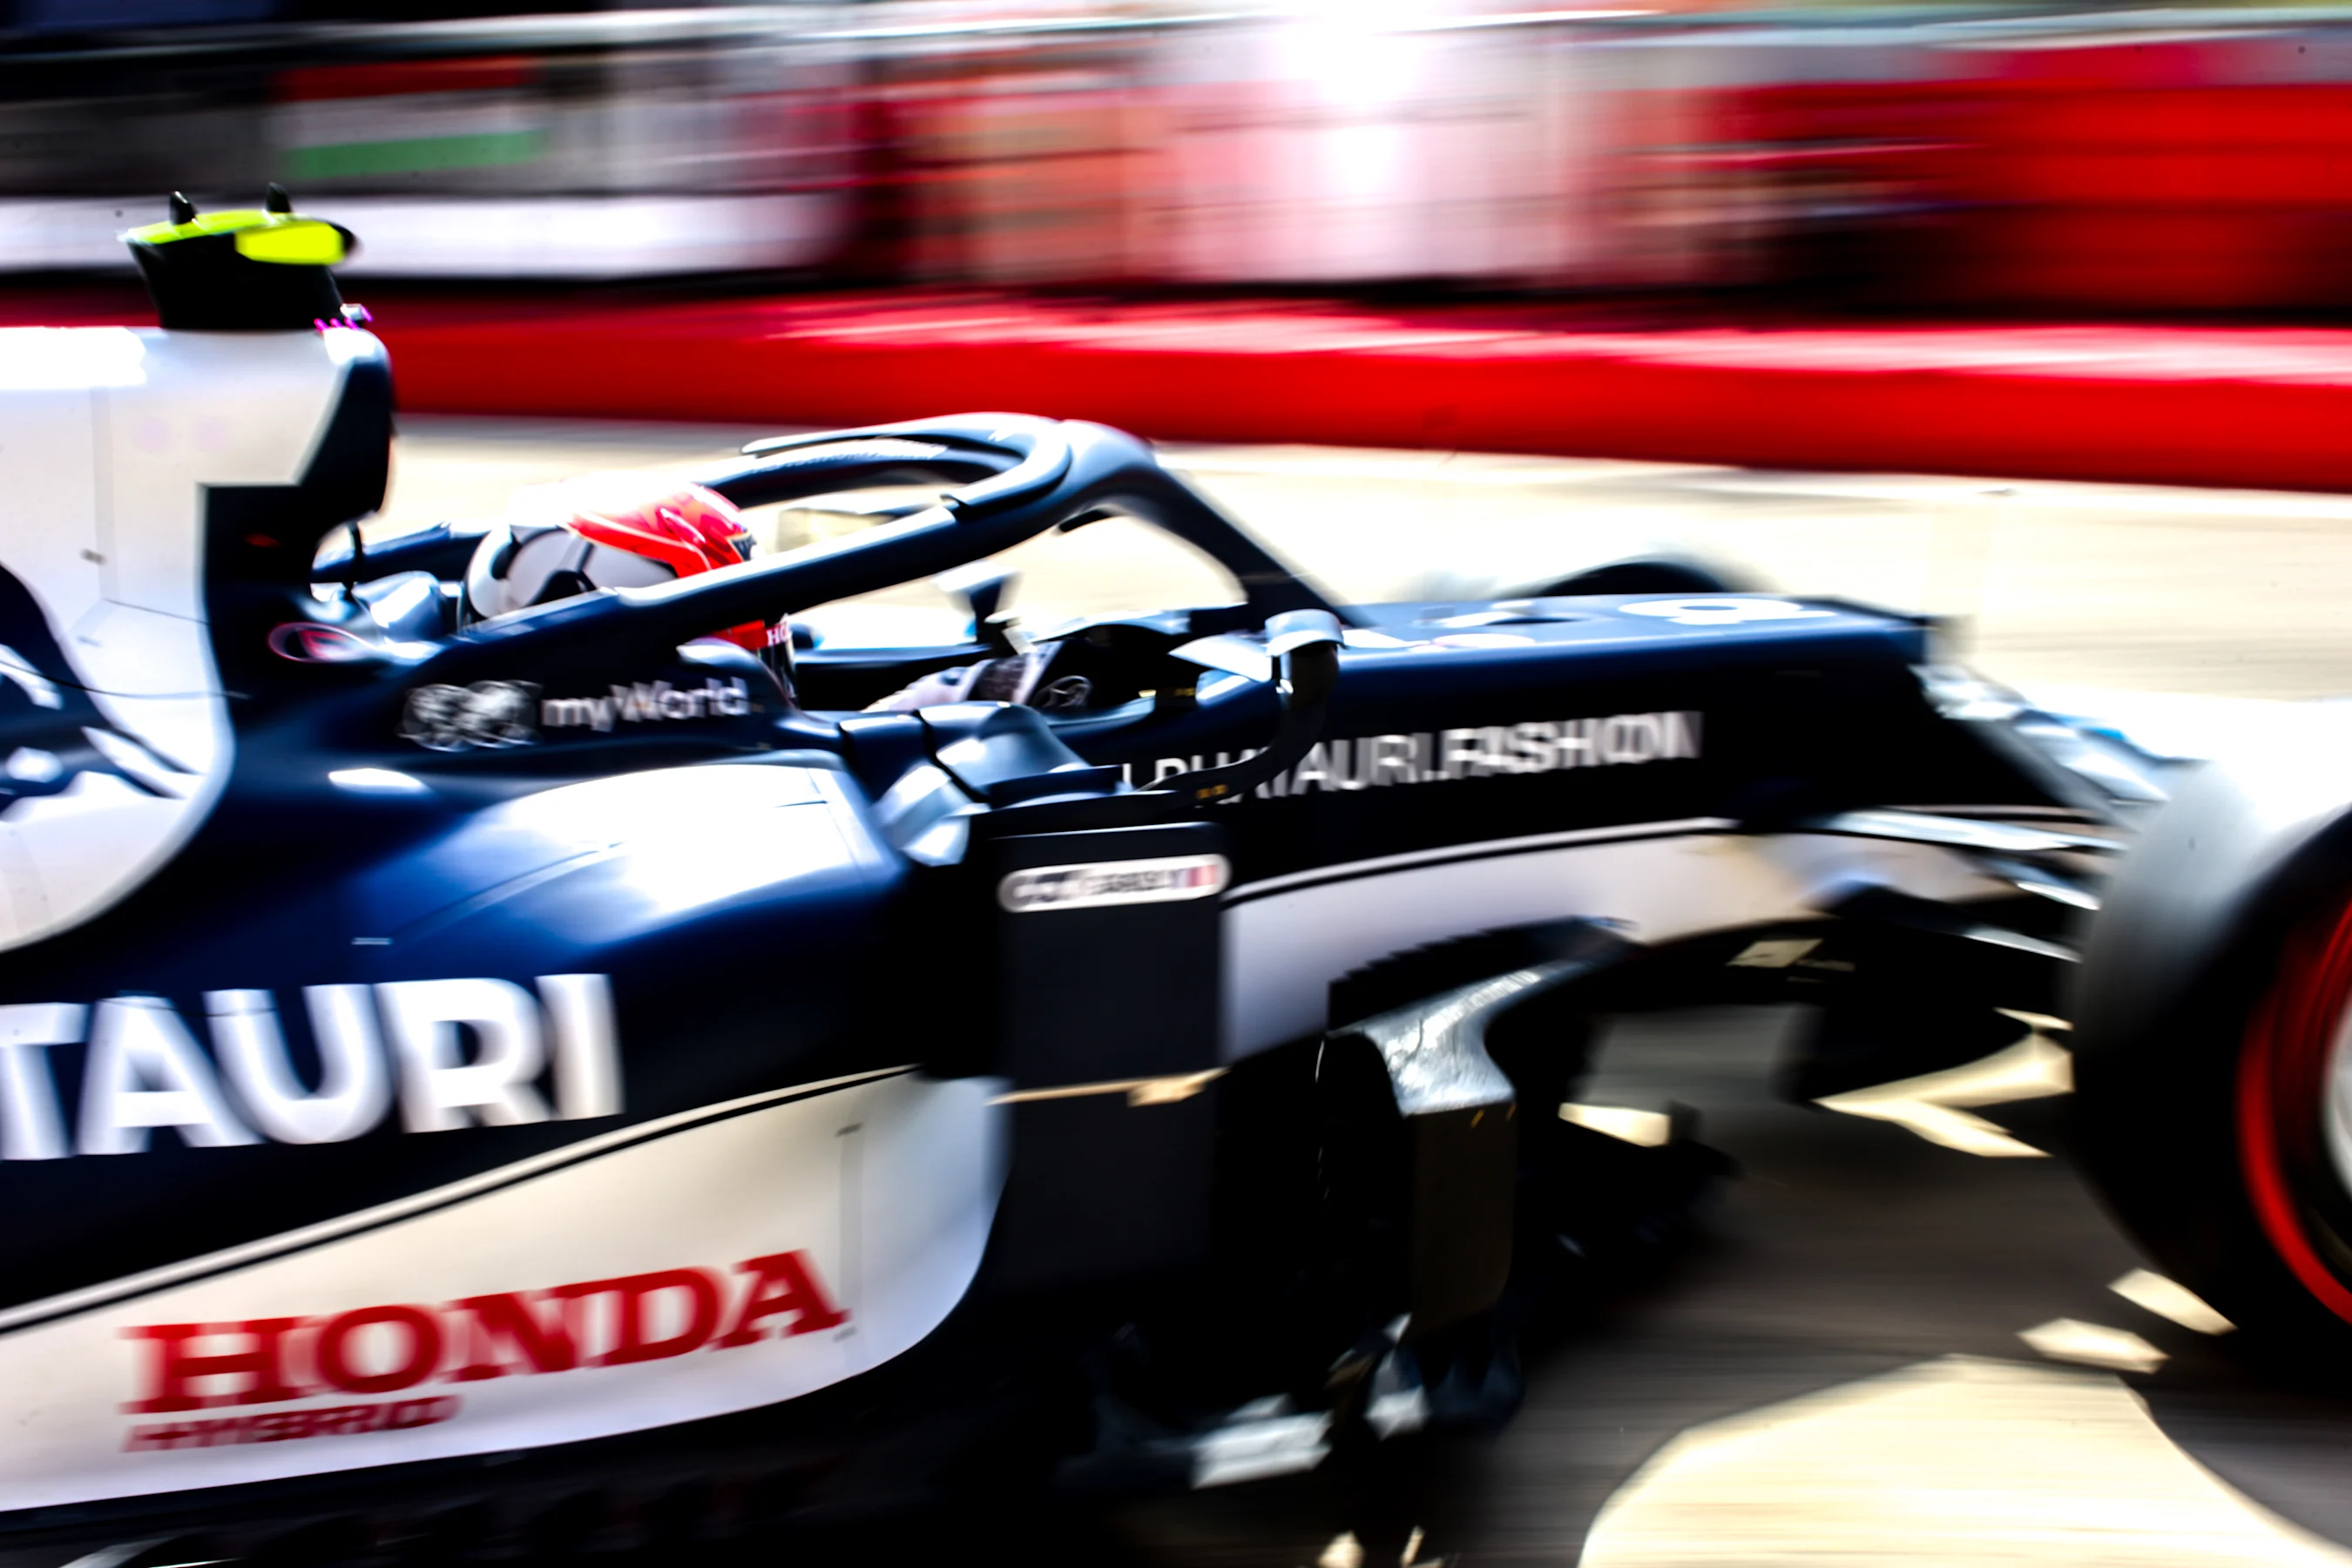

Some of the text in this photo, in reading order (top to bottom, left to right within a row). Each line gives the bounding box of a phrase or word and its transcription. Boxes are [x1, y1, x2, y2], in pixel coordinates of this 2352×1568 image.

[540, 676, 749, 733] myWorld
[0, 972, 624, 1160] TAURI
[113, 1248, 854, 1415] HONDA
[118, 1395, 463, 1453] HYBRID
